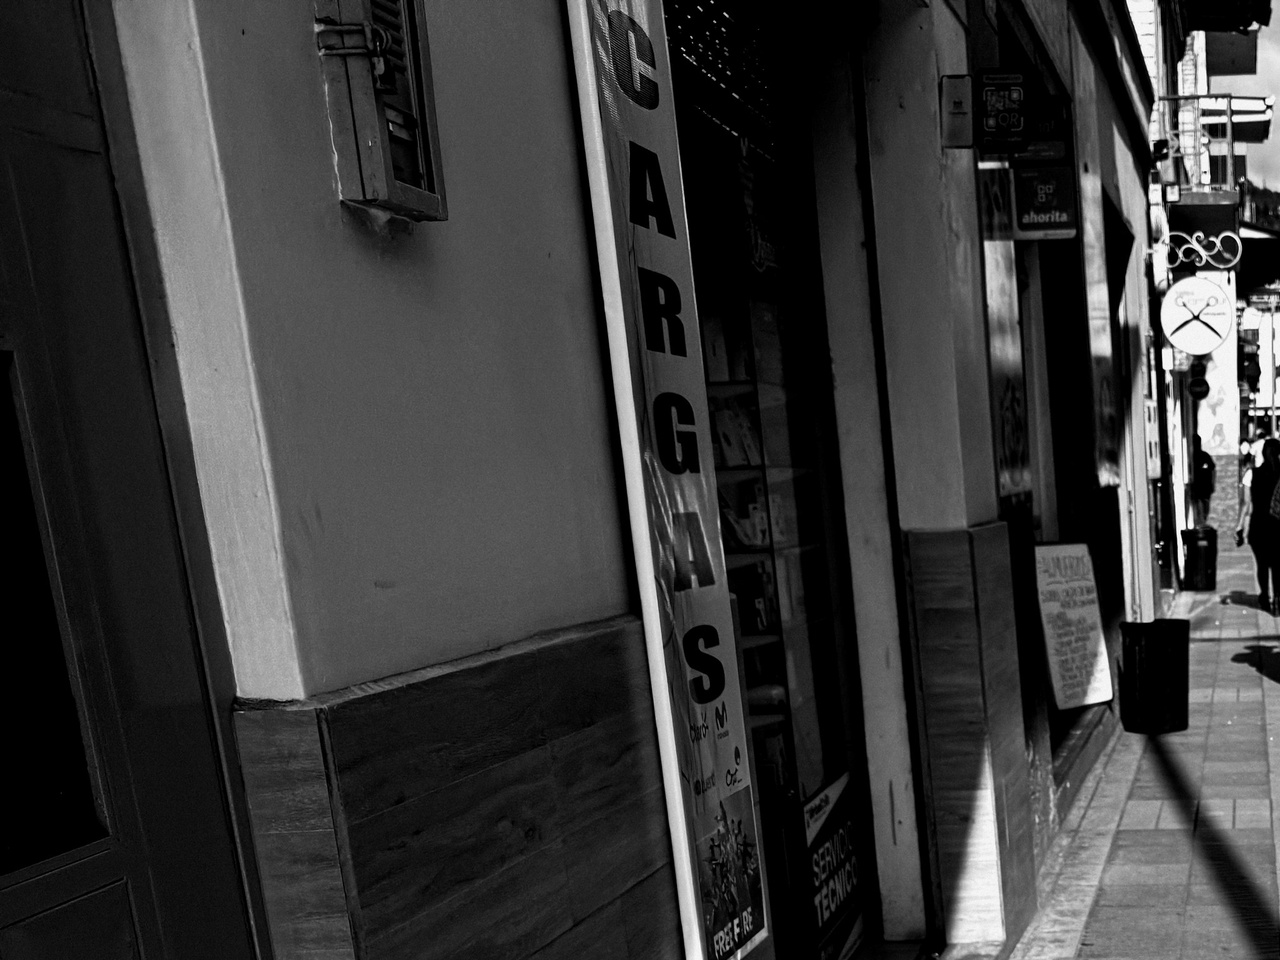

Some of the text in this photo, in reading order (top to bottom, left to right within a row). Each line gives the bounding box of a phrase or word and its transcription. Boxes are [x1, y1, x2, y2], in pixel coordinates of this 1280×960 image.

[998, 112, 1019, 128] QR
[1021, 209, 1068, 224] ahorita
[608, 9, 727, 704] CARGAS
[713, 921, 735, 960] FREE
